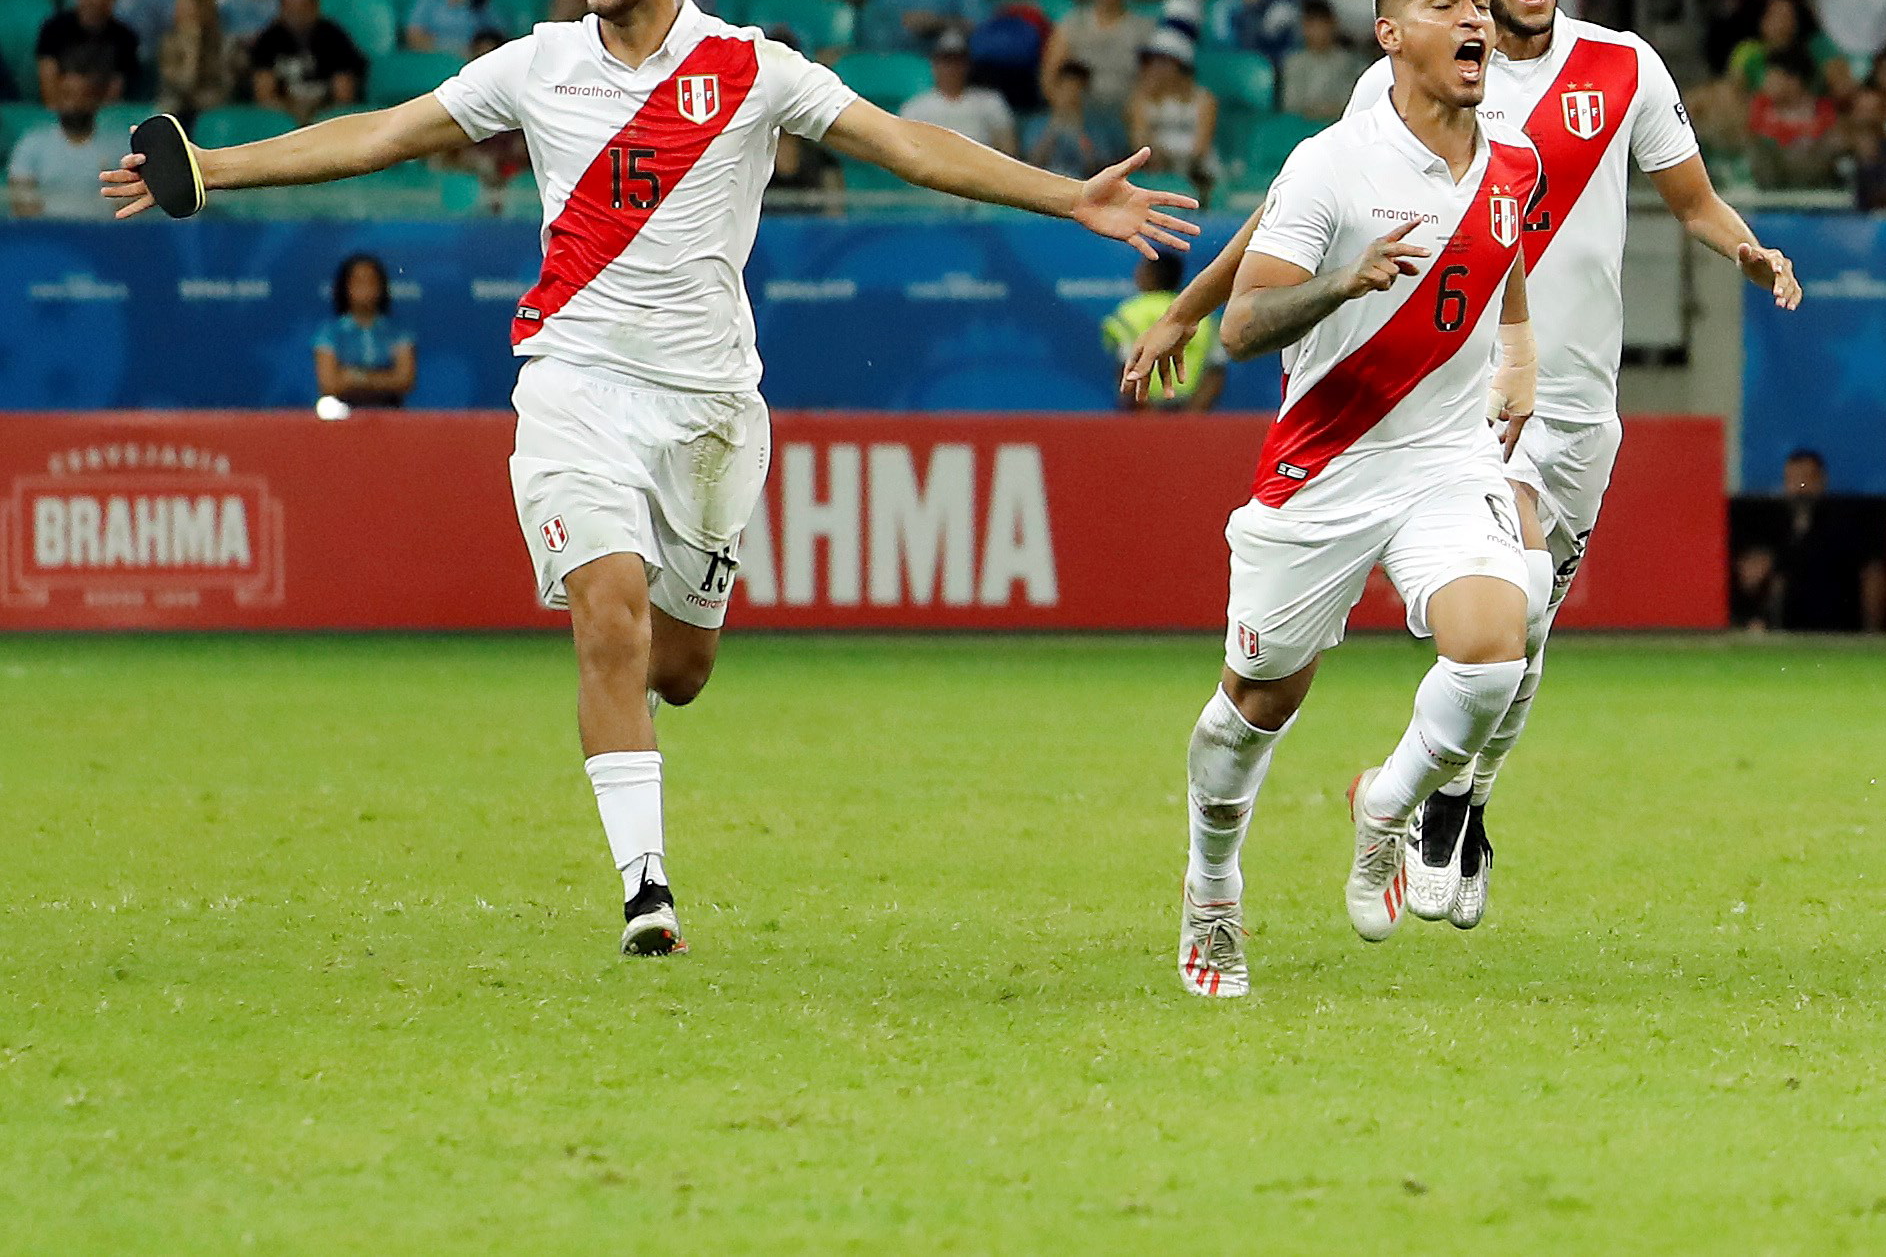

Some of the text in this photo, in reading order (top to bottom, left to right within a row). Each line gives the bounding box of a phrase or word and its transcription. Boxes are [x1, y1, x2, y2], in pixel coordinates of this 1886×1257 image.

[554, 84, 622, 100] marathon
[608, 146, 662, 210] 15
[1434, 264, 1471, 332] 6
[33, 495, 251, 570] BRAHMA
